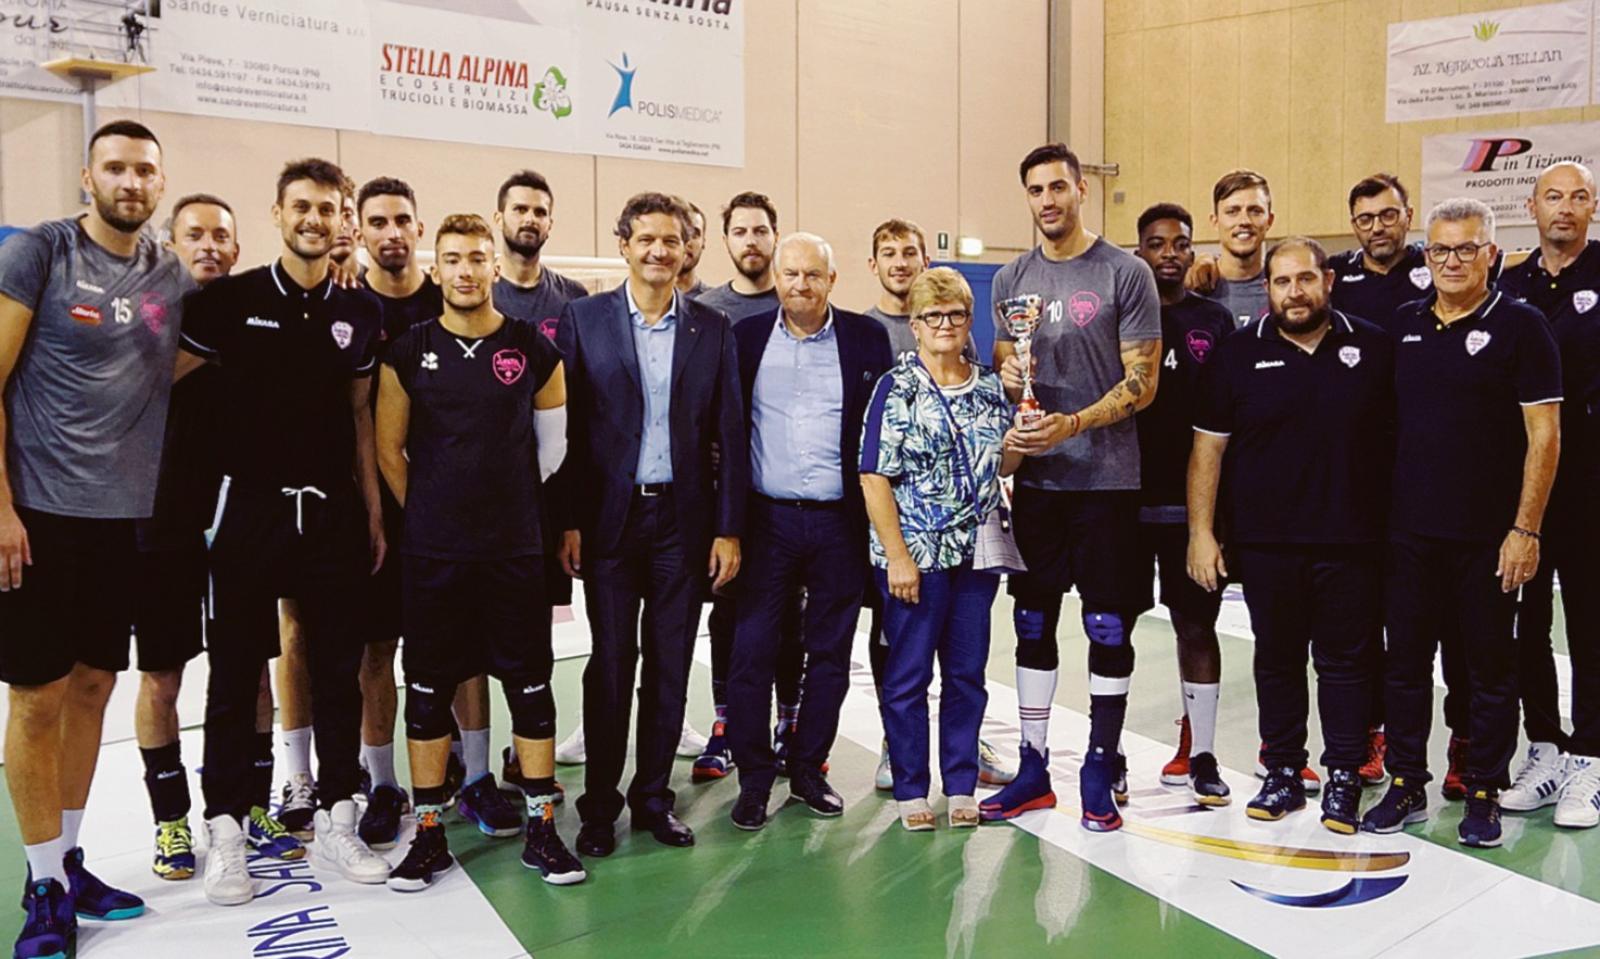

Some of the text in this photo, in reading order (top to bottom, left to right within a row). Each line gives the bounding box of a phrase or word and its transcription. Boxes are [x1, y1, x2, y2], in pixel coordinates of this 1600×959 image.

[167, 0, 229, 17] Sandre
[236, 5, 339, 33] Verniciatura
[586, 0, 629, 13] PAUSA
[636, 6, 680, 22] SENZA
[688, 15, 730, 30] SOSTA
[180, 52, 195, 62] Via
[381, 42, 528, 89] STELLA ALPINA
[1507, 50, 1562, 66] TELLAN
[381, 88, 528, 115] TRUCIOLI E BIOMASSA
[1465, 177, 1514, 188] PRODOTTI
[111, 297, 133, 324] 15
[1047, 300, 1063, 323] 10
[1164, 348, 1178, 370] 4
